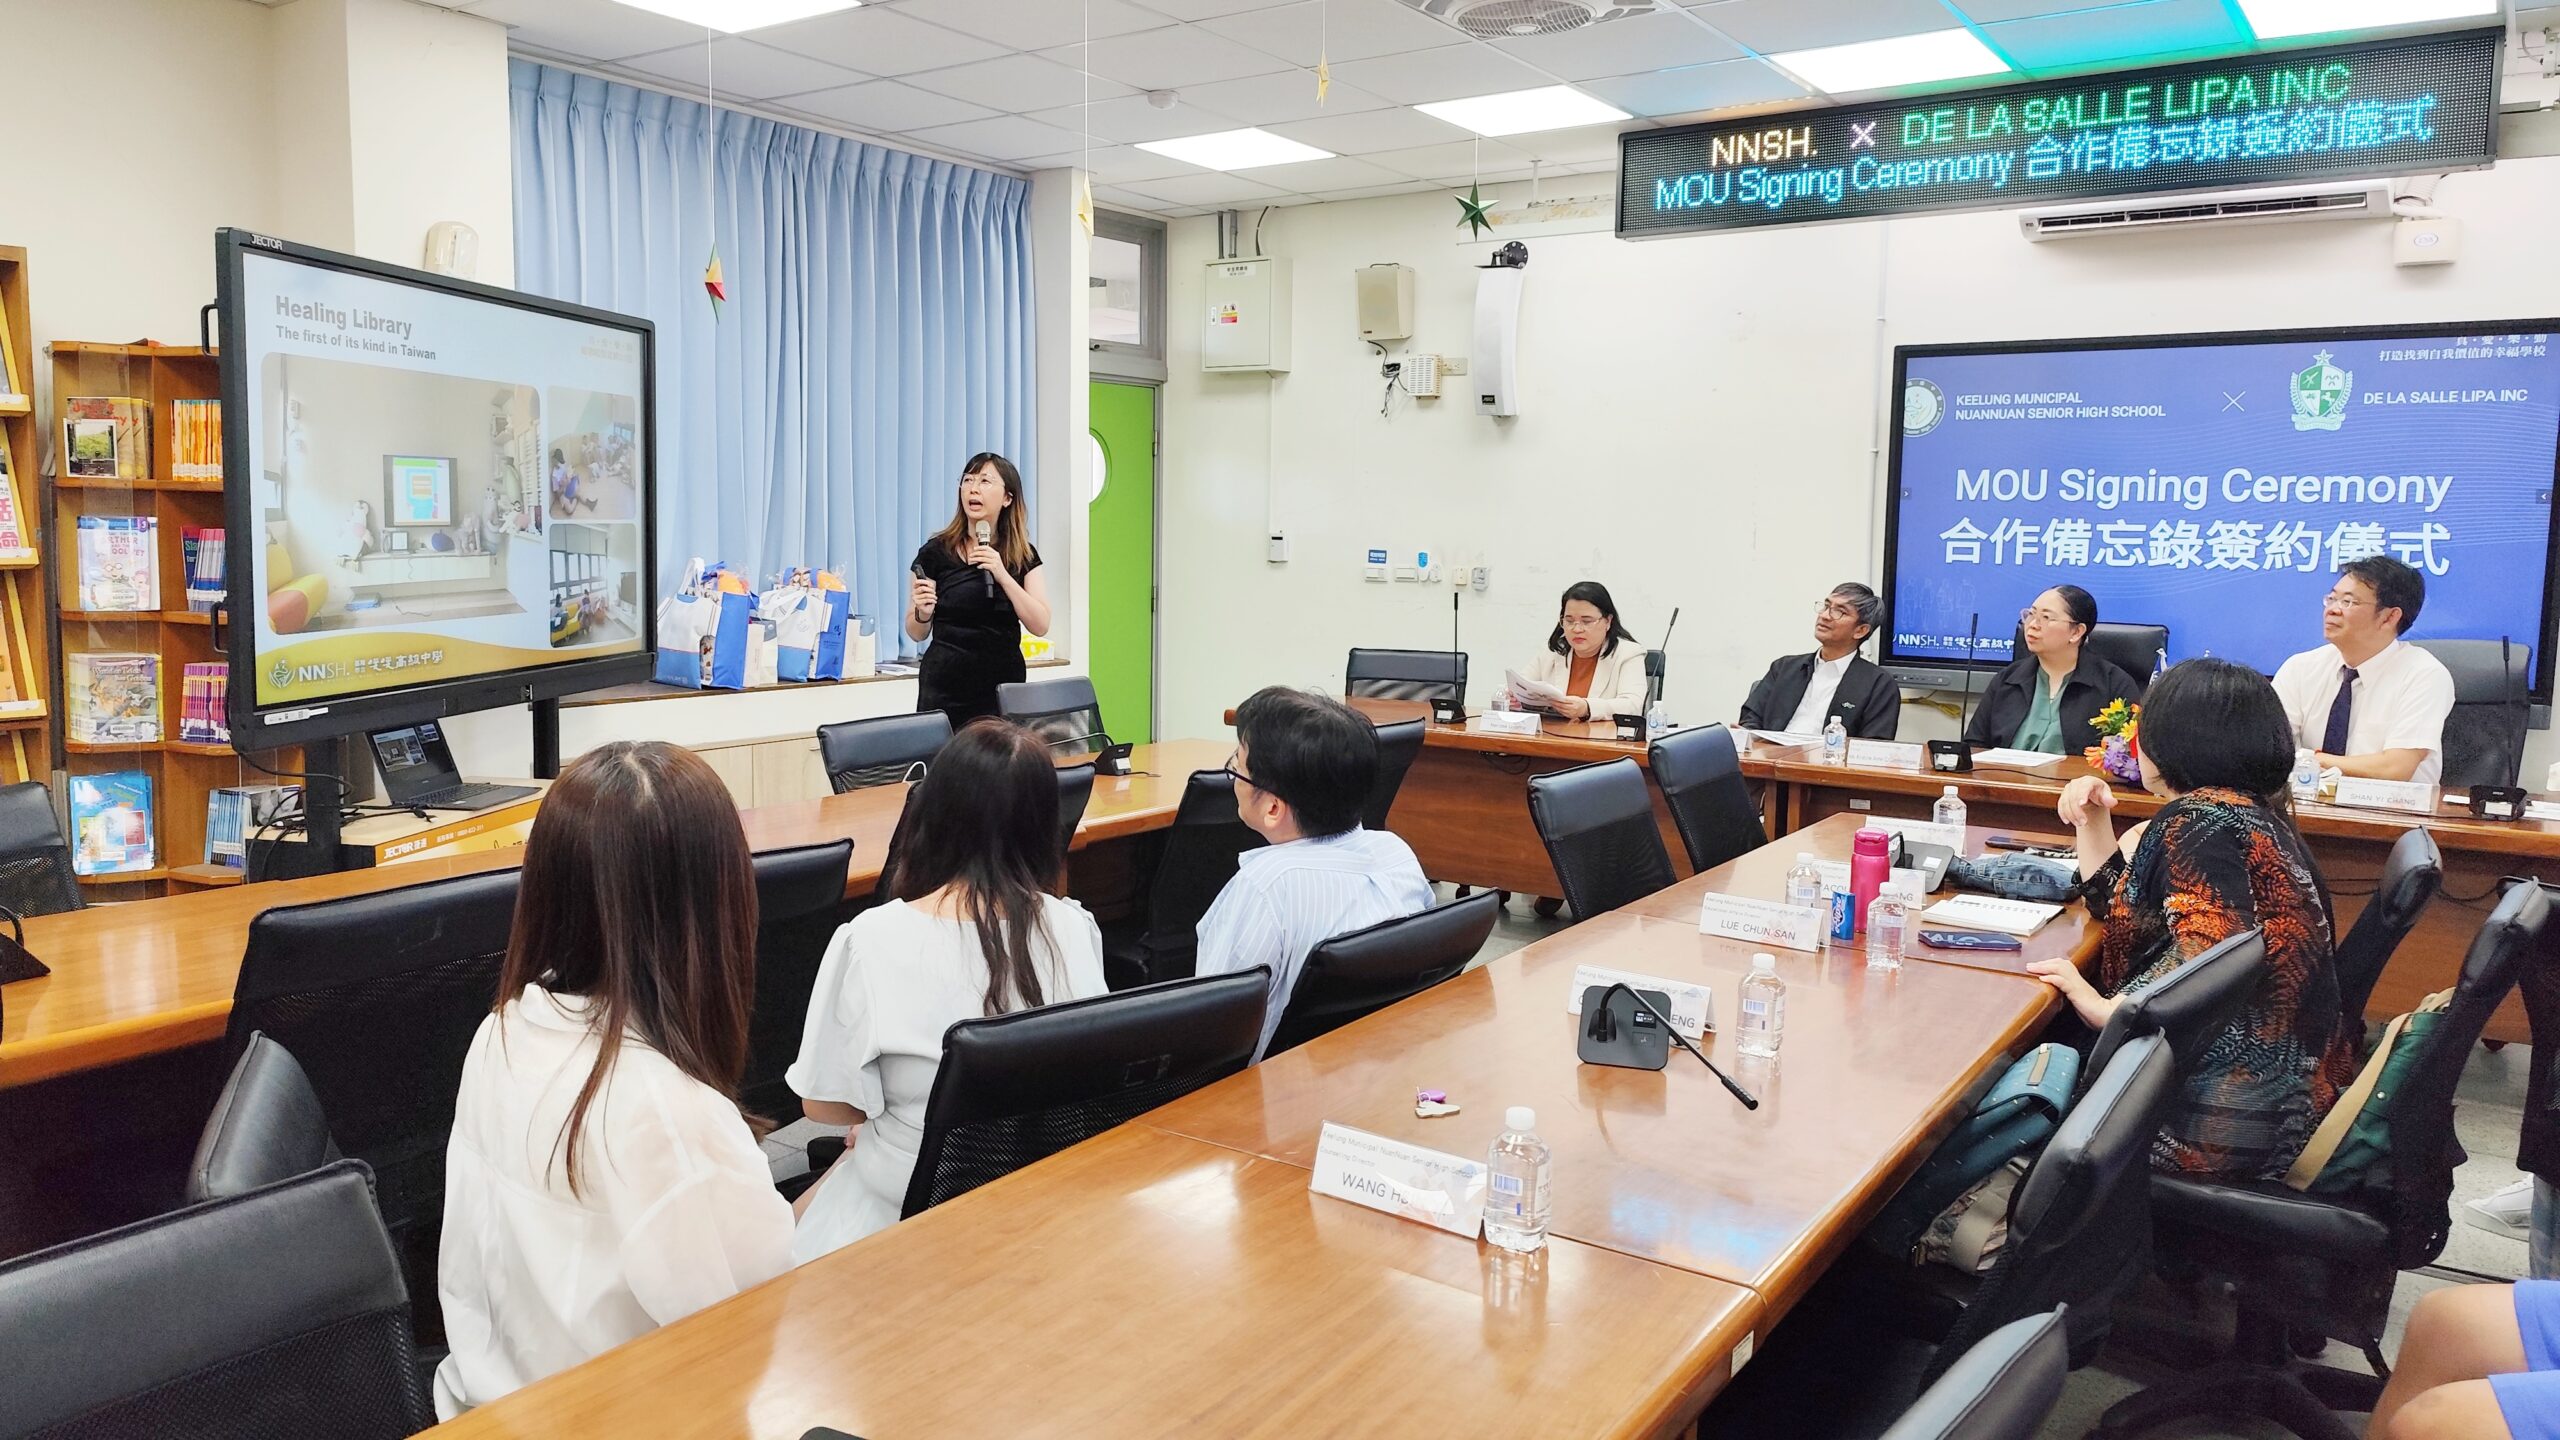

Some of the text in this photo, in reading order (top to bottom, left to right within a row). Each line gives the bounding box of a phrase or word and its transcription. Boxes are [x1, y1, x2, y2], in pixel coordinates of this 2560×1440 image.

[1711, 126, 1818, 167] NNSH.
[1903, 109, 1955, 147] DE
[1967, 103, 2013, 140] LA
[2024, 85, 2150, 132] SALLE
[2164, 74, 2257, 119] LIPA
[2271, 62, 2350, 105] INC
[1656, 170, 1732, 210] MOU
[1738, 162, 1844, 209] Signing
[1852, 151, 2015, 190] Ceremony
[251, 233, 283, 251] JECTOR
[275, 295, 412, 341] Healing Library
[275, 324, 436, 361] The first of its kind in Taiwan
[1956, 392, 2083, 406] KEELUNG MUNICIPAL
[2363, 389, 2529, 405] DE LA SALLE LIPA INC
[1955, 405, 2167, 421] NUANNUAN SENIOR HIGH SCHOOL
[1955, 467, 2455, 512] MOU Signing Ceremony
[1938, 516, 2452, 577] 合作備忘錄簽約儀式
[1898, 633, 1940, 647] NNSH.
[298, 661, 350, 682] NNSH.
[383, 841, 414, 859] JECTOR
[1720, 919, 1796, 941] LUE CHUN SAN
[1342, 1171, 1387, 1198] WANG
